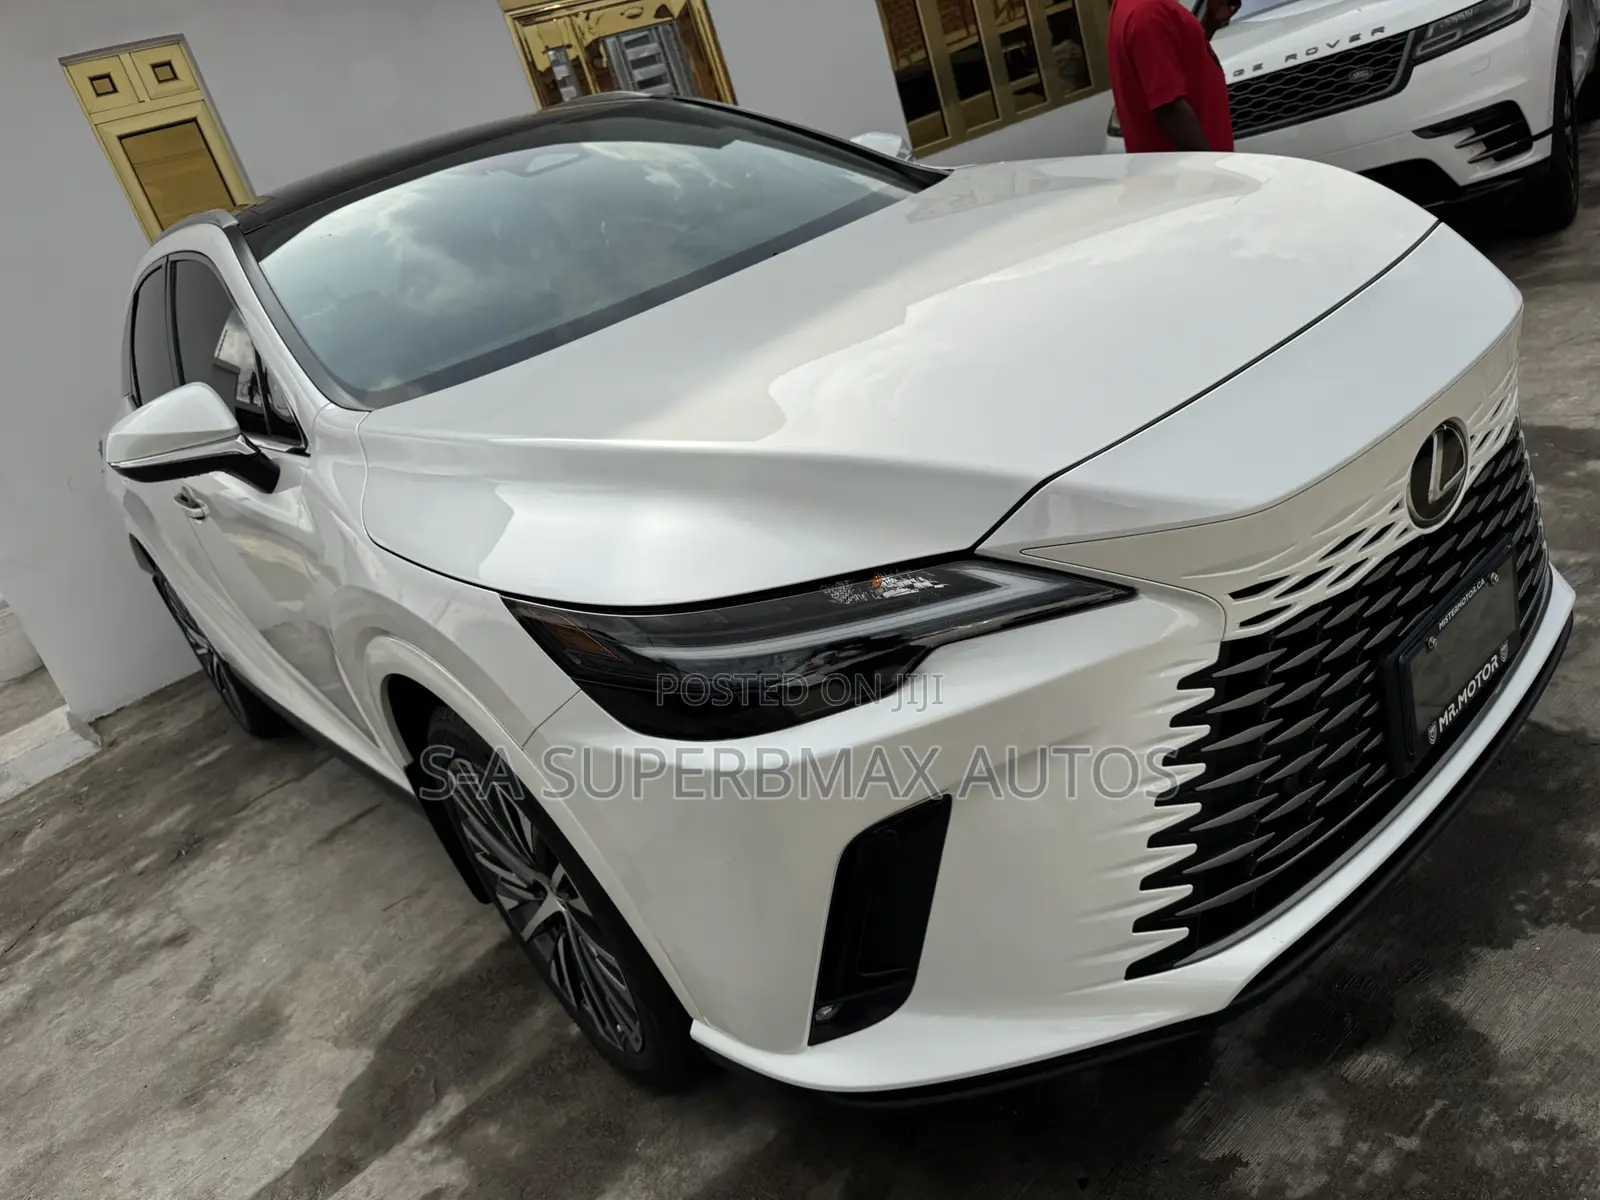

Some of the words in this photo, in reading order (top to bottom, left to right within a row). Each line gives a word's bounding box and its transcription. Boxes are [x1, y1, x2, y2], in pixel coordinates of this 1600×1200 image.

[1285, 26, 1385, 62] ROVER
[1439, 578, 1485, 630] MISTERMOTOR.CA
[1438, 655, 1499, 733] MR.MOTOR
